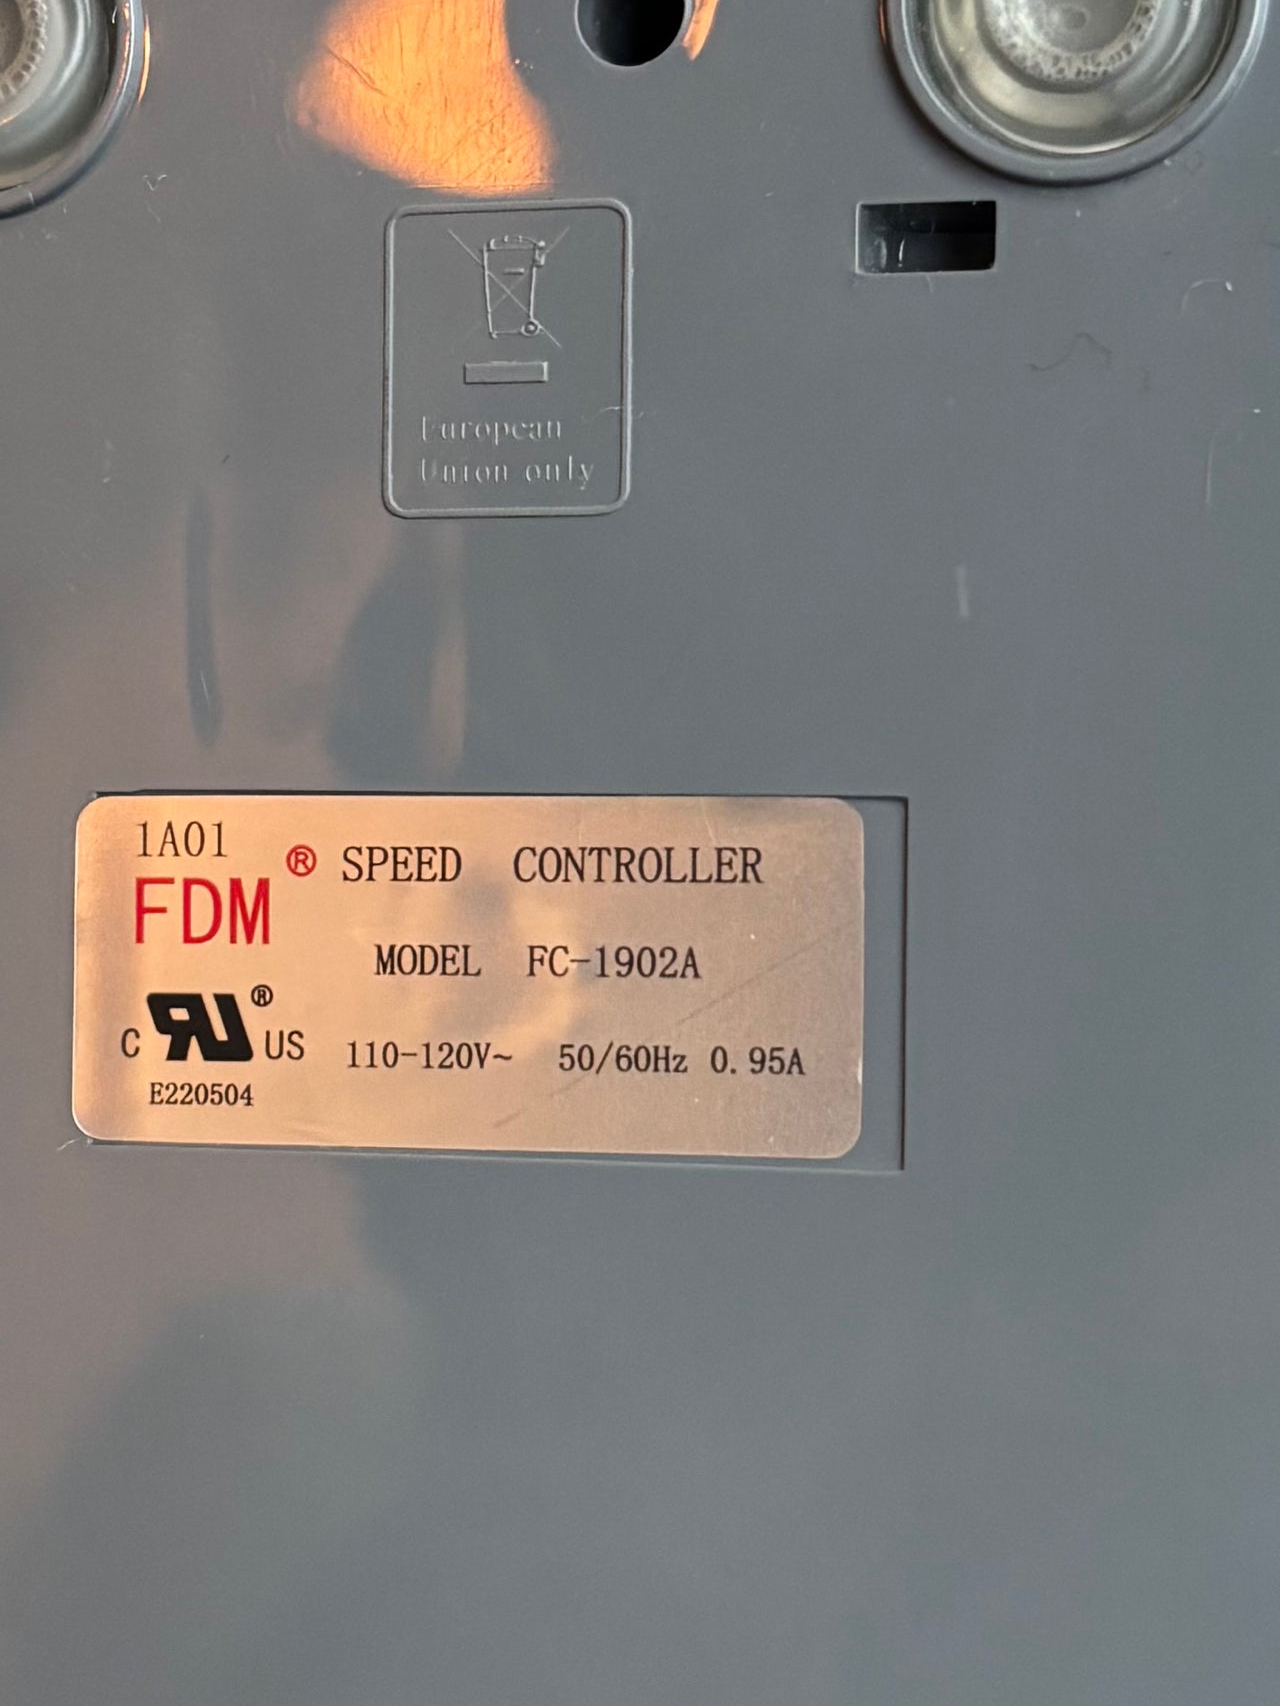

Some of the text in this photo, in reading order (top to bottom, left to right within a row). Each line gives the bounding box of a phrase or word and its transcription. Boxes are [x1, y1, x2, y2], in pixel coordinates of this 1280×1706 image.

[421, 415, 562, 445] European
[421, 455, 594, 490] Union only
[136, 820, 228, 858] 1A01
[342, 845, 764, 884] SPEED CONTROLLER
[134, 876, 271, 945] FDM
[373, 944, 702, 980] MODEL FC-1902A
[264, 1030, 305, 1061] US
[558, 1041, 688, 1074] 50/60Hz
[148, 1081, 254, 1107] E220504
